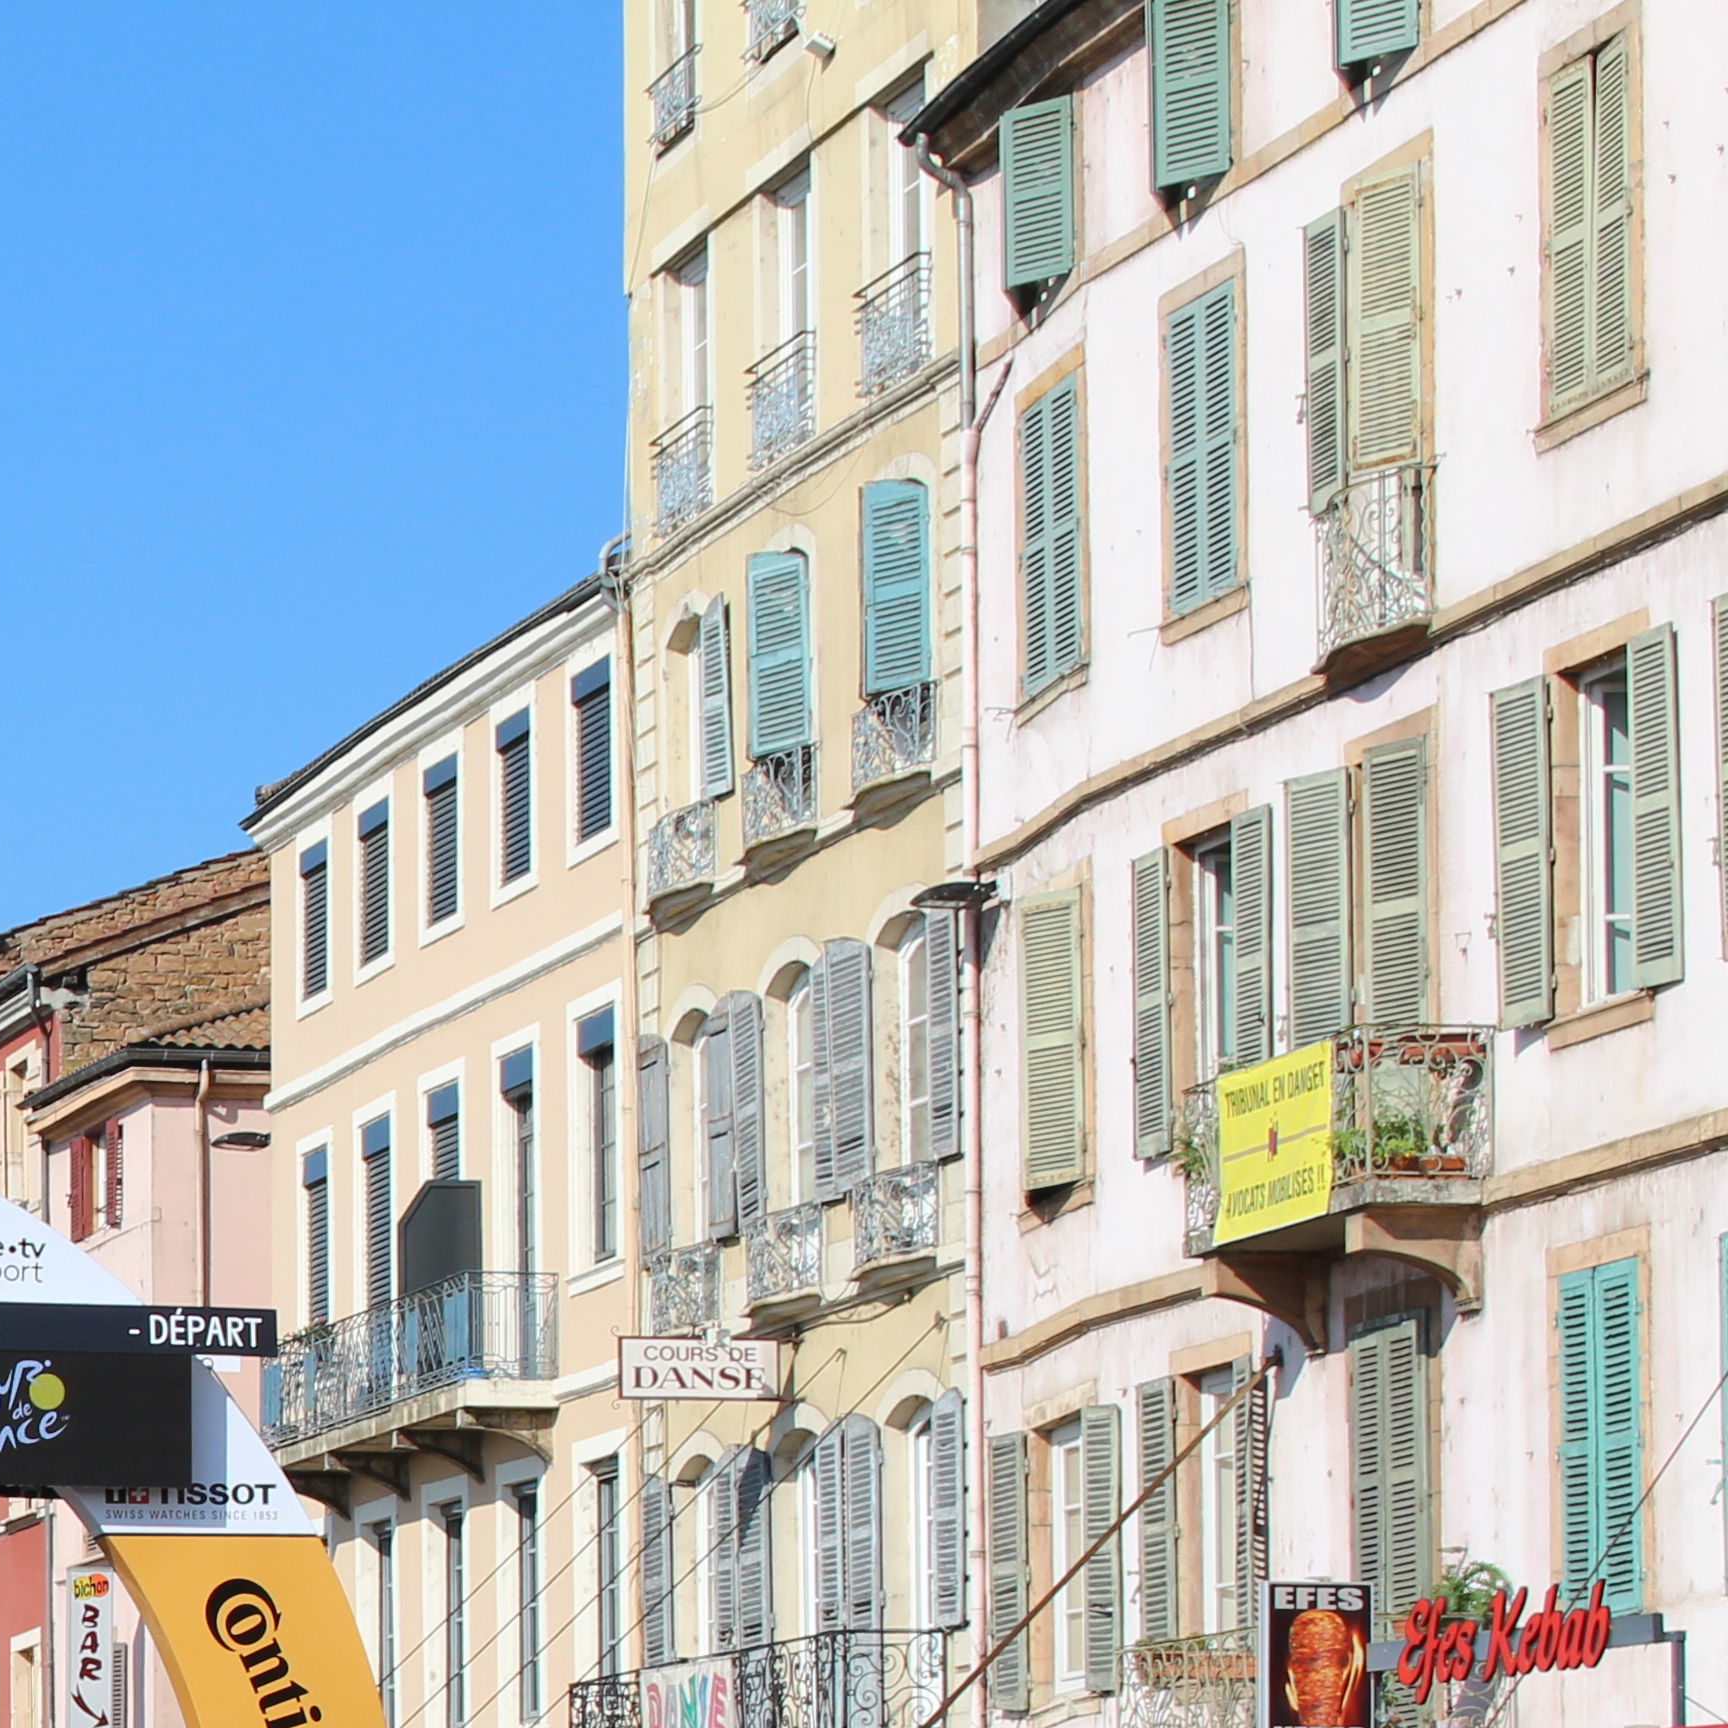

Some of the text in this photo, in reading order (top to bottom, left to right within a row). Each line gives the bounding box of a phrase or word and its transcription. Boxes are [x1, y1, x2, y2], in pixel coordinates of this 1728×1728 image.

[1224, 1061, 1326, 1120] TRIBUNAL EN DANGER
[1225, 1182, 1266, 1220] AVOCATS
[148, 1309, 263, 1349] DÉPART
[642, 1344, 757, 1364] COURS DE
[631, 1365, 768, 1391] DANSE
[11, 1400, 33, 1421] de
[105, 1508, 278, 1521] SWISS WATCHES SINCE 1853
[74, 1575, 109, 1601] bichon
[1274, 1585, 1365, 1611] EFES
[78, 1602, 102, 1682] BAR
[1397, 1578, 1612, 1706] Efes Kebab
